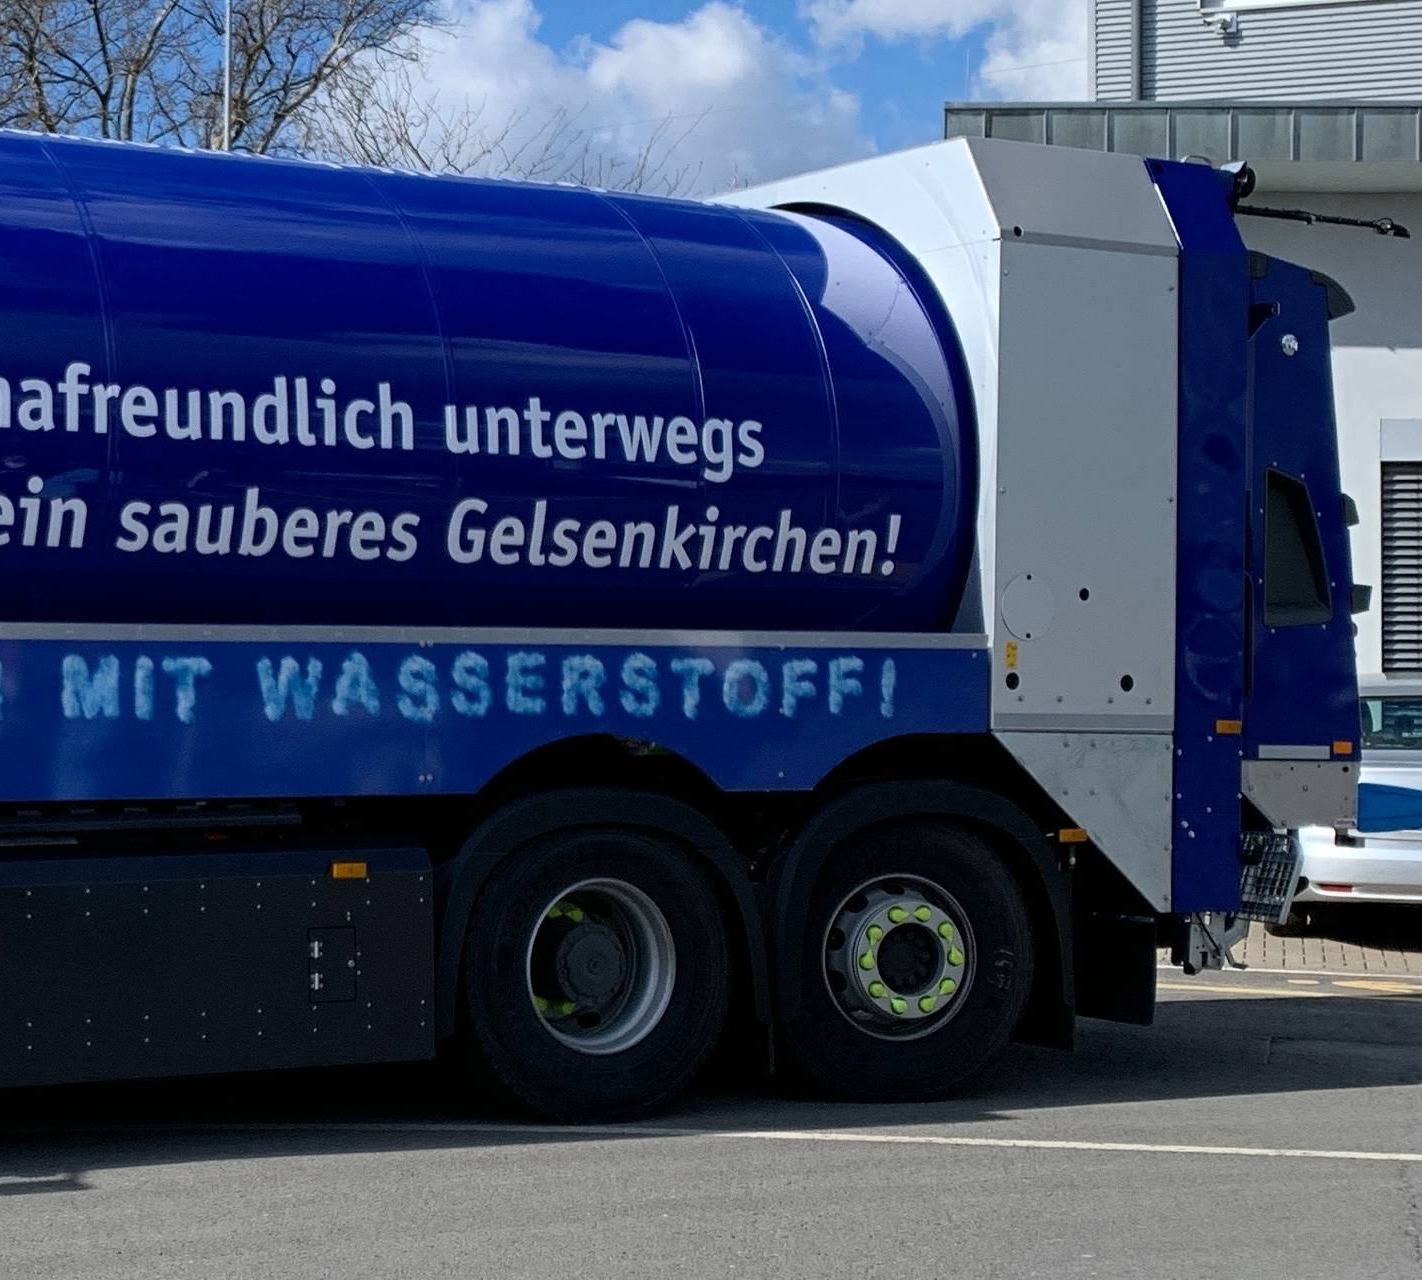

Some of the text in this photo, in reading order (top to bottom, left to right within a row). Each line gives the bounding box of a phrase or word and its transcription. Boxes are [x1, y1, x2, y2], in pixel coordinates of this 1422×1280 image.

[444, 397, 766, 483] unterwegs
[115, 487, 421, 561] sauberes
[447, 498, 902, 576] Gelsenkirchen!
[61, 653, 213, 724] MIT
[255, 650, 897, 723] WASSERSTOFF!
